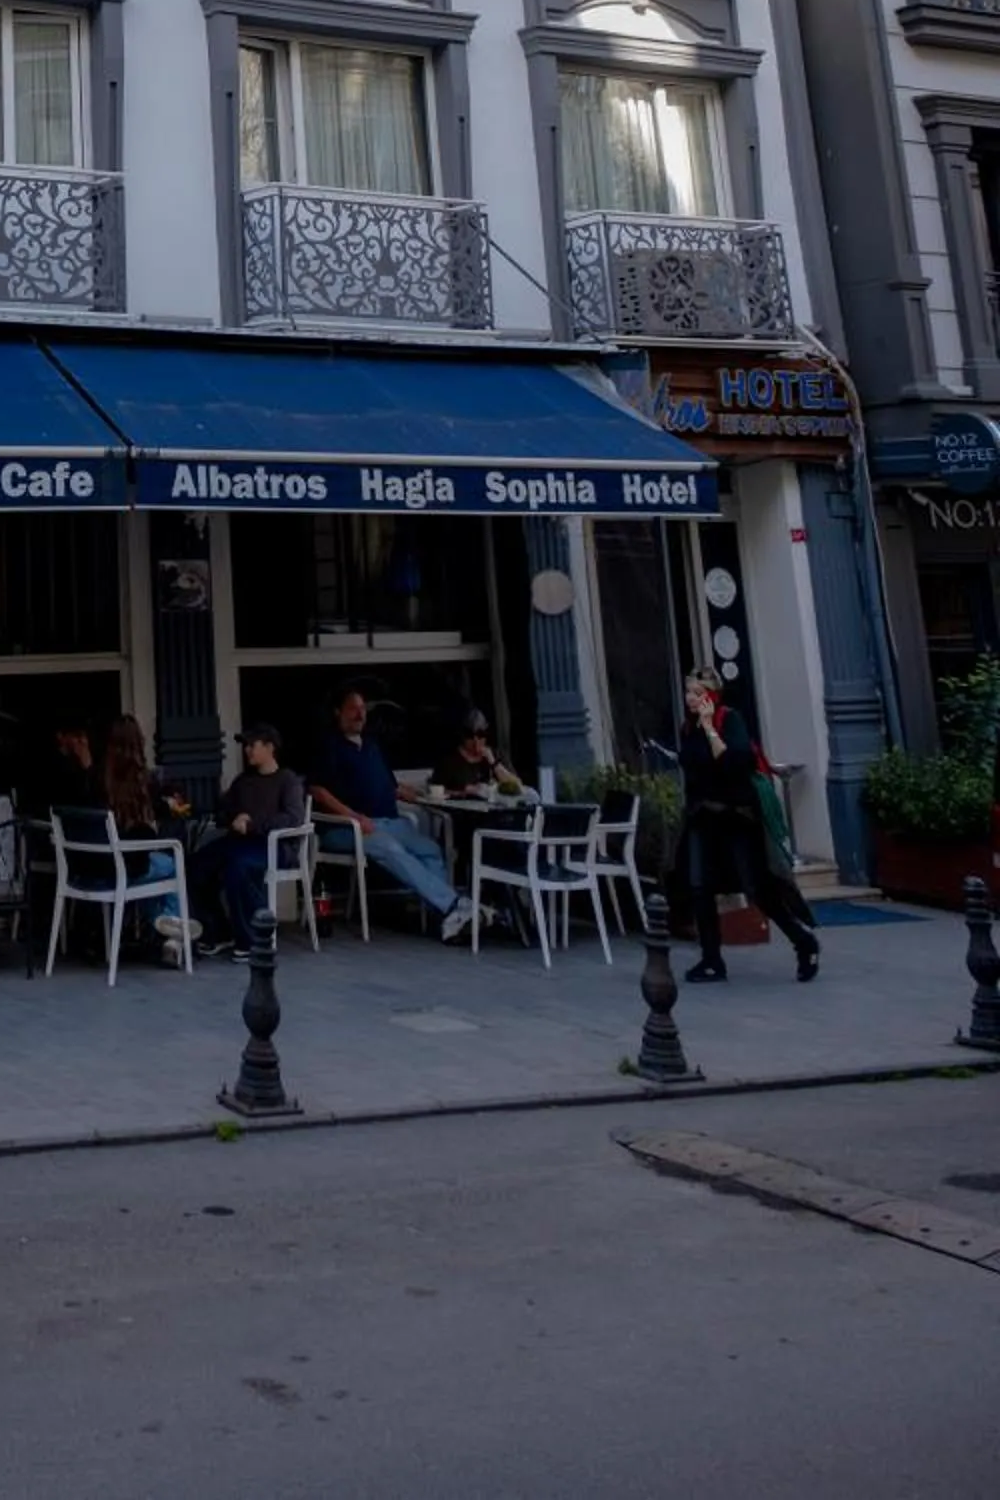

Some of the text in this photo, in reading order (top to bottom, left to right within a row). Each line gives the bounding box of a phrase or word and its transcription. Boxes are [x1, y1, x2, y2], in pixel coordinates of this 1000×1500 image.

[718, 366, 849, 409] HOTEL
[937, 448, 996, 463] COFFEE
[0, 461, 94, 498] Cafe
[171, 463, 328, 500] Albatros
[360, 468, 455, 509] Hagia
[485, 471, 597, 510] Sophia
[622, 473, 697, 505] Hotel
[928, 499, 1000, 530] NO:1
